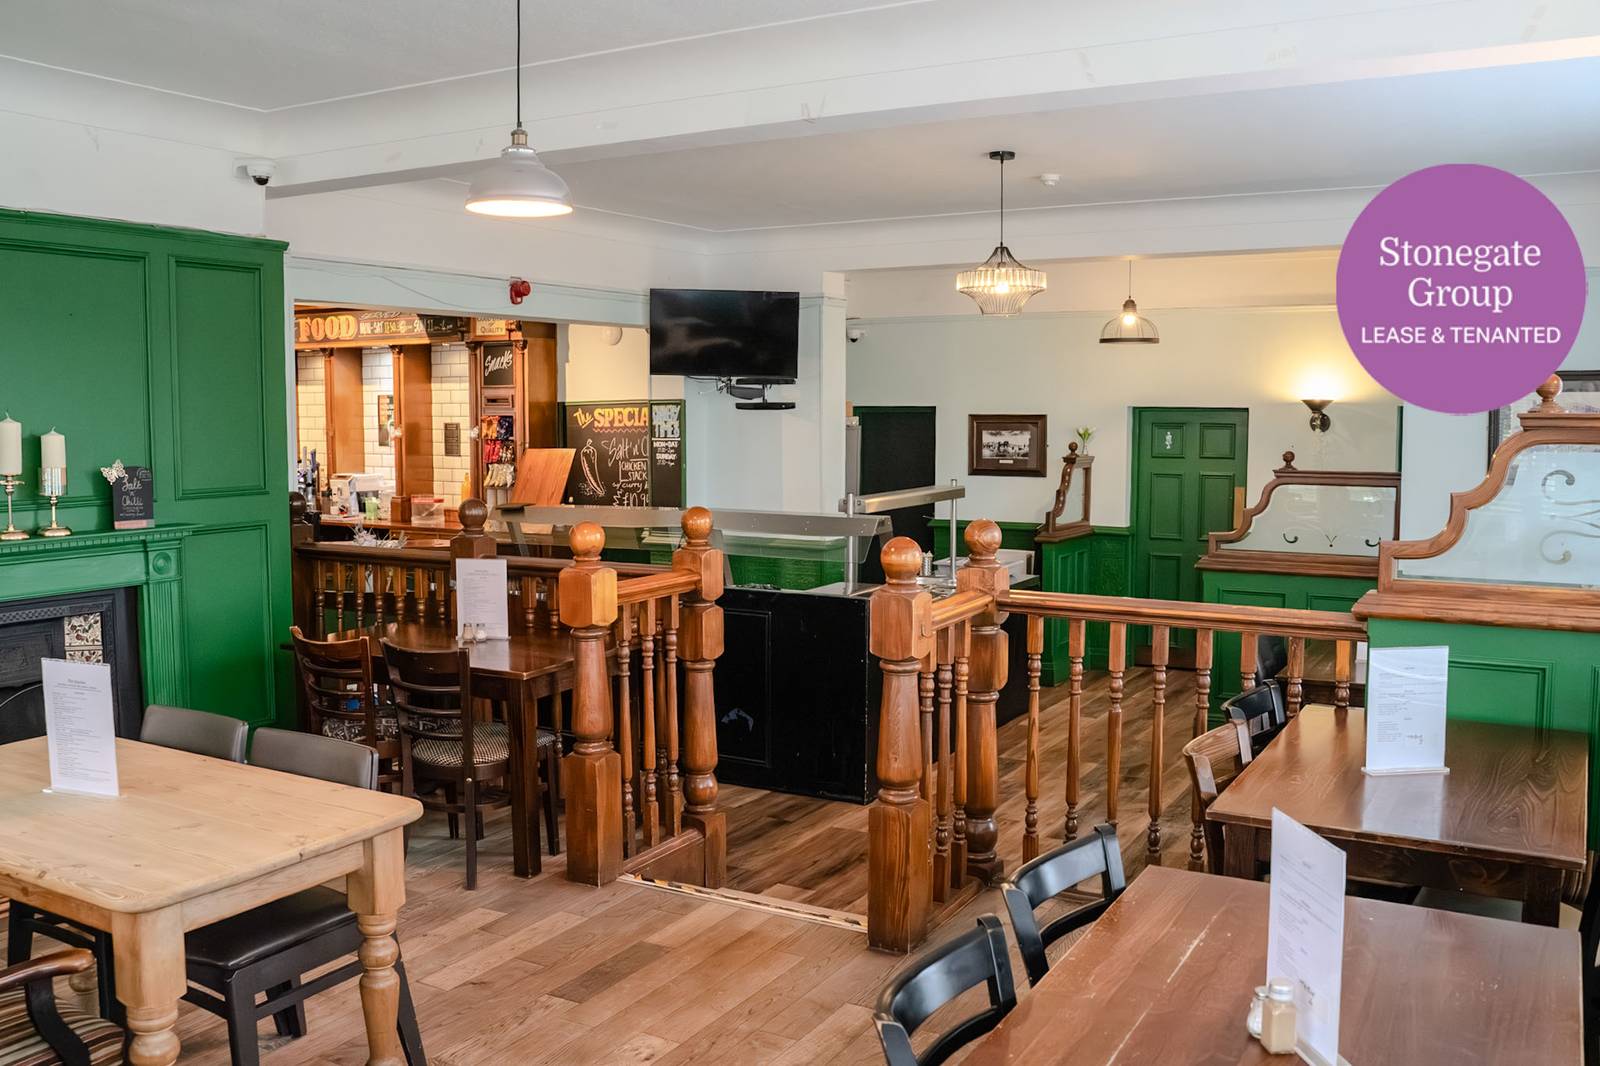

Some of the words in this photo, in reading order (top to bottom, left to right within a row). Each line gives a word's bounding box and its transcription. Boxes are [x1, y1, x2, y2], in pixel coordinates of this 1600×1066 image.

[296, 315, 358, 343] FOOD
[573, 408, 593, 427] The
[621, 461, 647, 471] CHICKEN
[628, 471, 649, 481] STACK
[621, 483, 643, 493] curry
